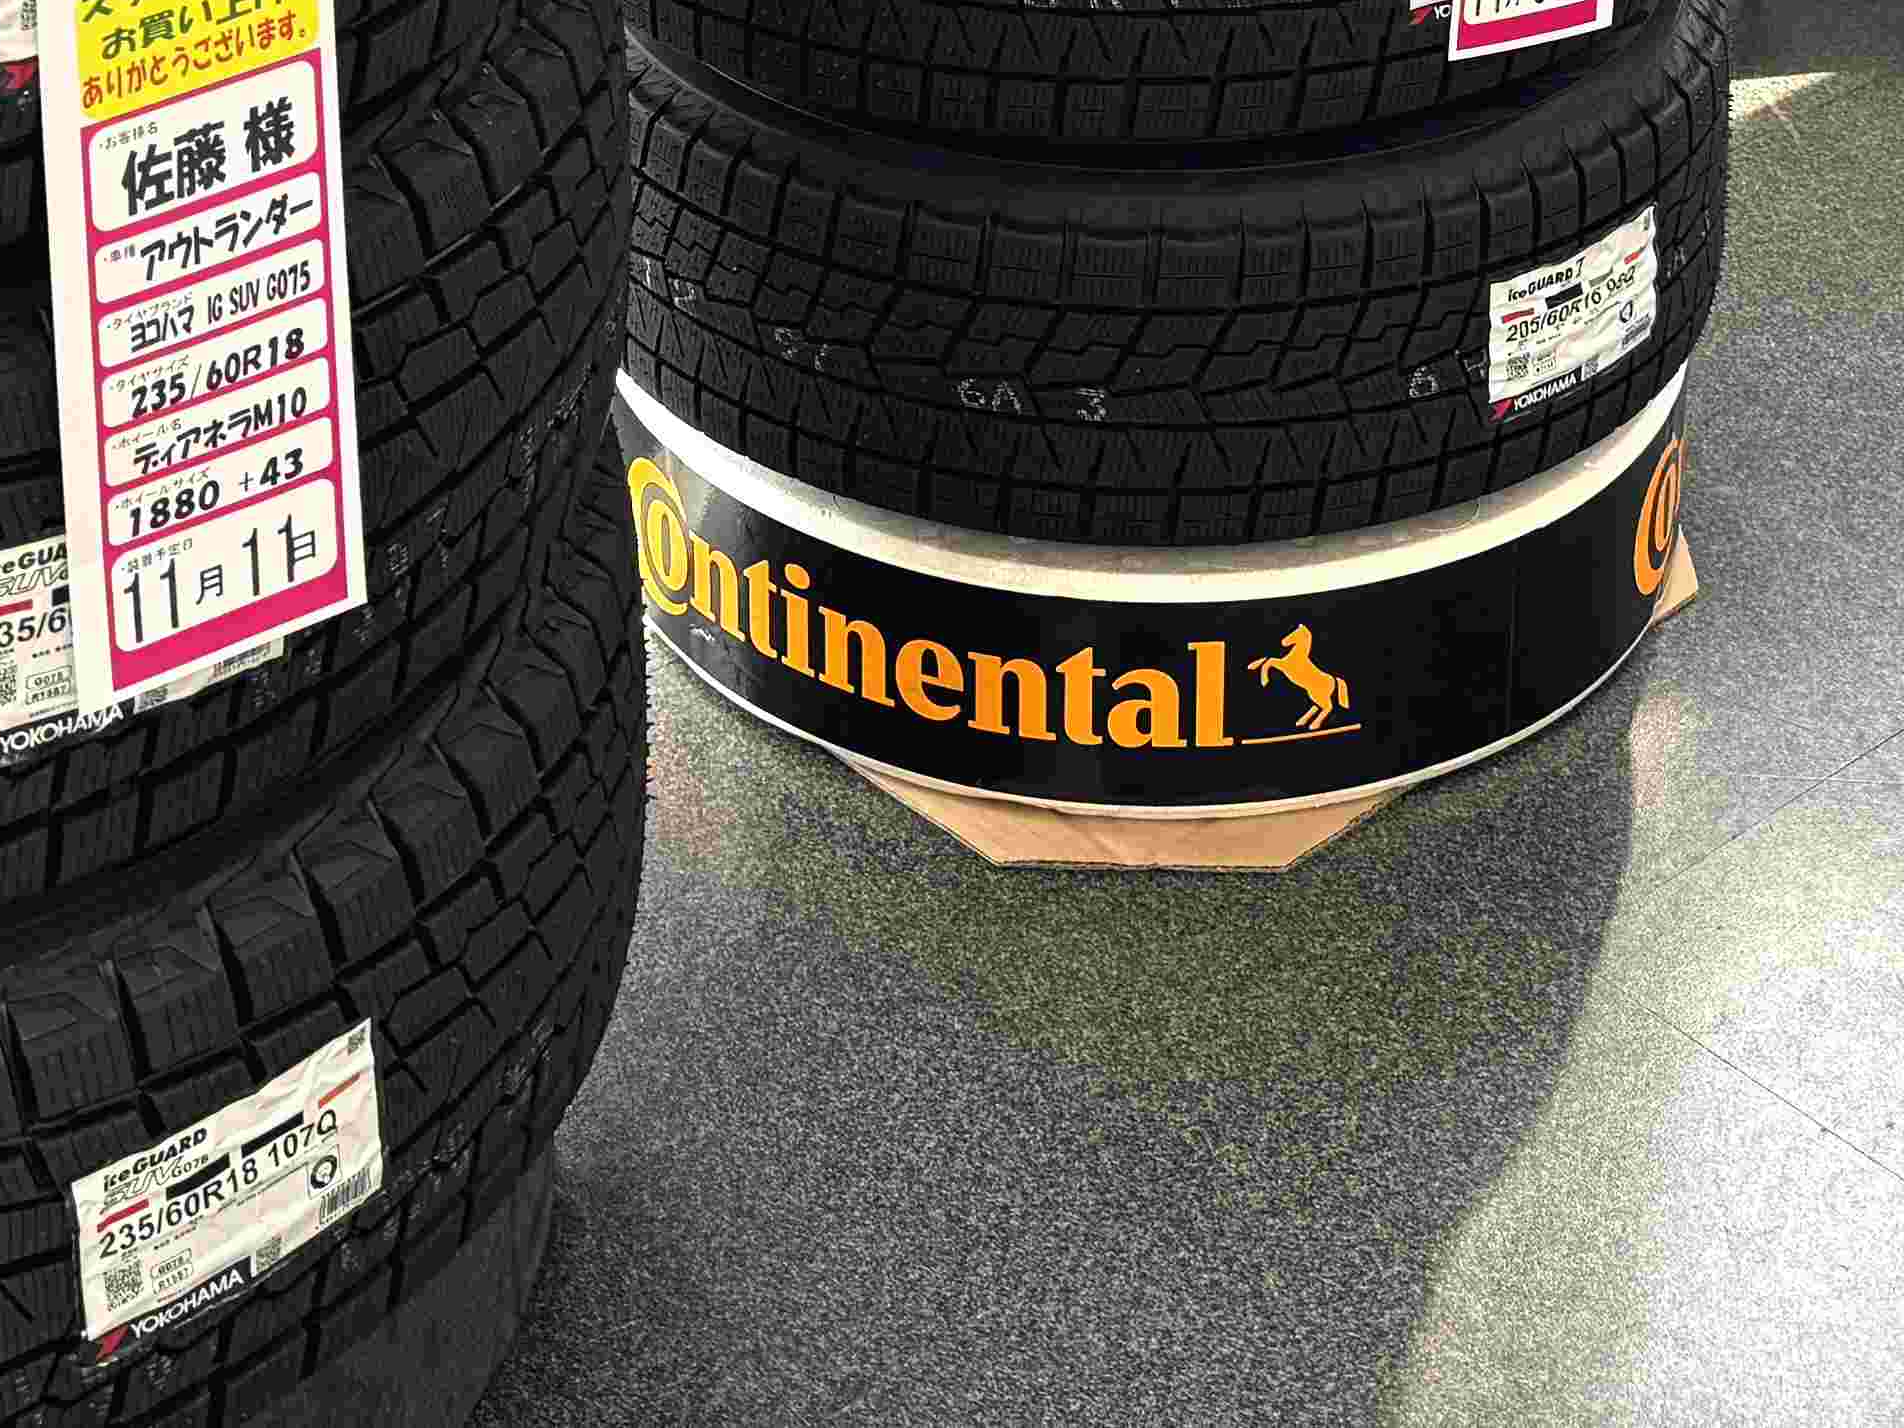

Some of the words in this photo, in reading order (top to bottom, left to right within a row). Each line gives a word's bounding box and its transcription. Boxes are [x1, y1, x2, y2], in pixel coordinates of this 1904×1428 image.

[80, 9, 307, 110] ありがとうございます。
[121, 120, 227, 217] 佐藤
[243, 95, 296, 174] 様
[140, 192, 314, 281] アウトランダー
[130, 304, 195, 353] ヨコハマ
[228, 277, 261, 317] SUV
[130, 327, 306, 419] 235/60R18
[129, 479, 221, 538] 1880
[626, 452, 1236, 749] Continental
[103, 1126, 209, 1193] iceGUARD
[98, 1157, 260, 1261] 235/60R18
[129, 1268, 246, 1340] YOKOHAMA
